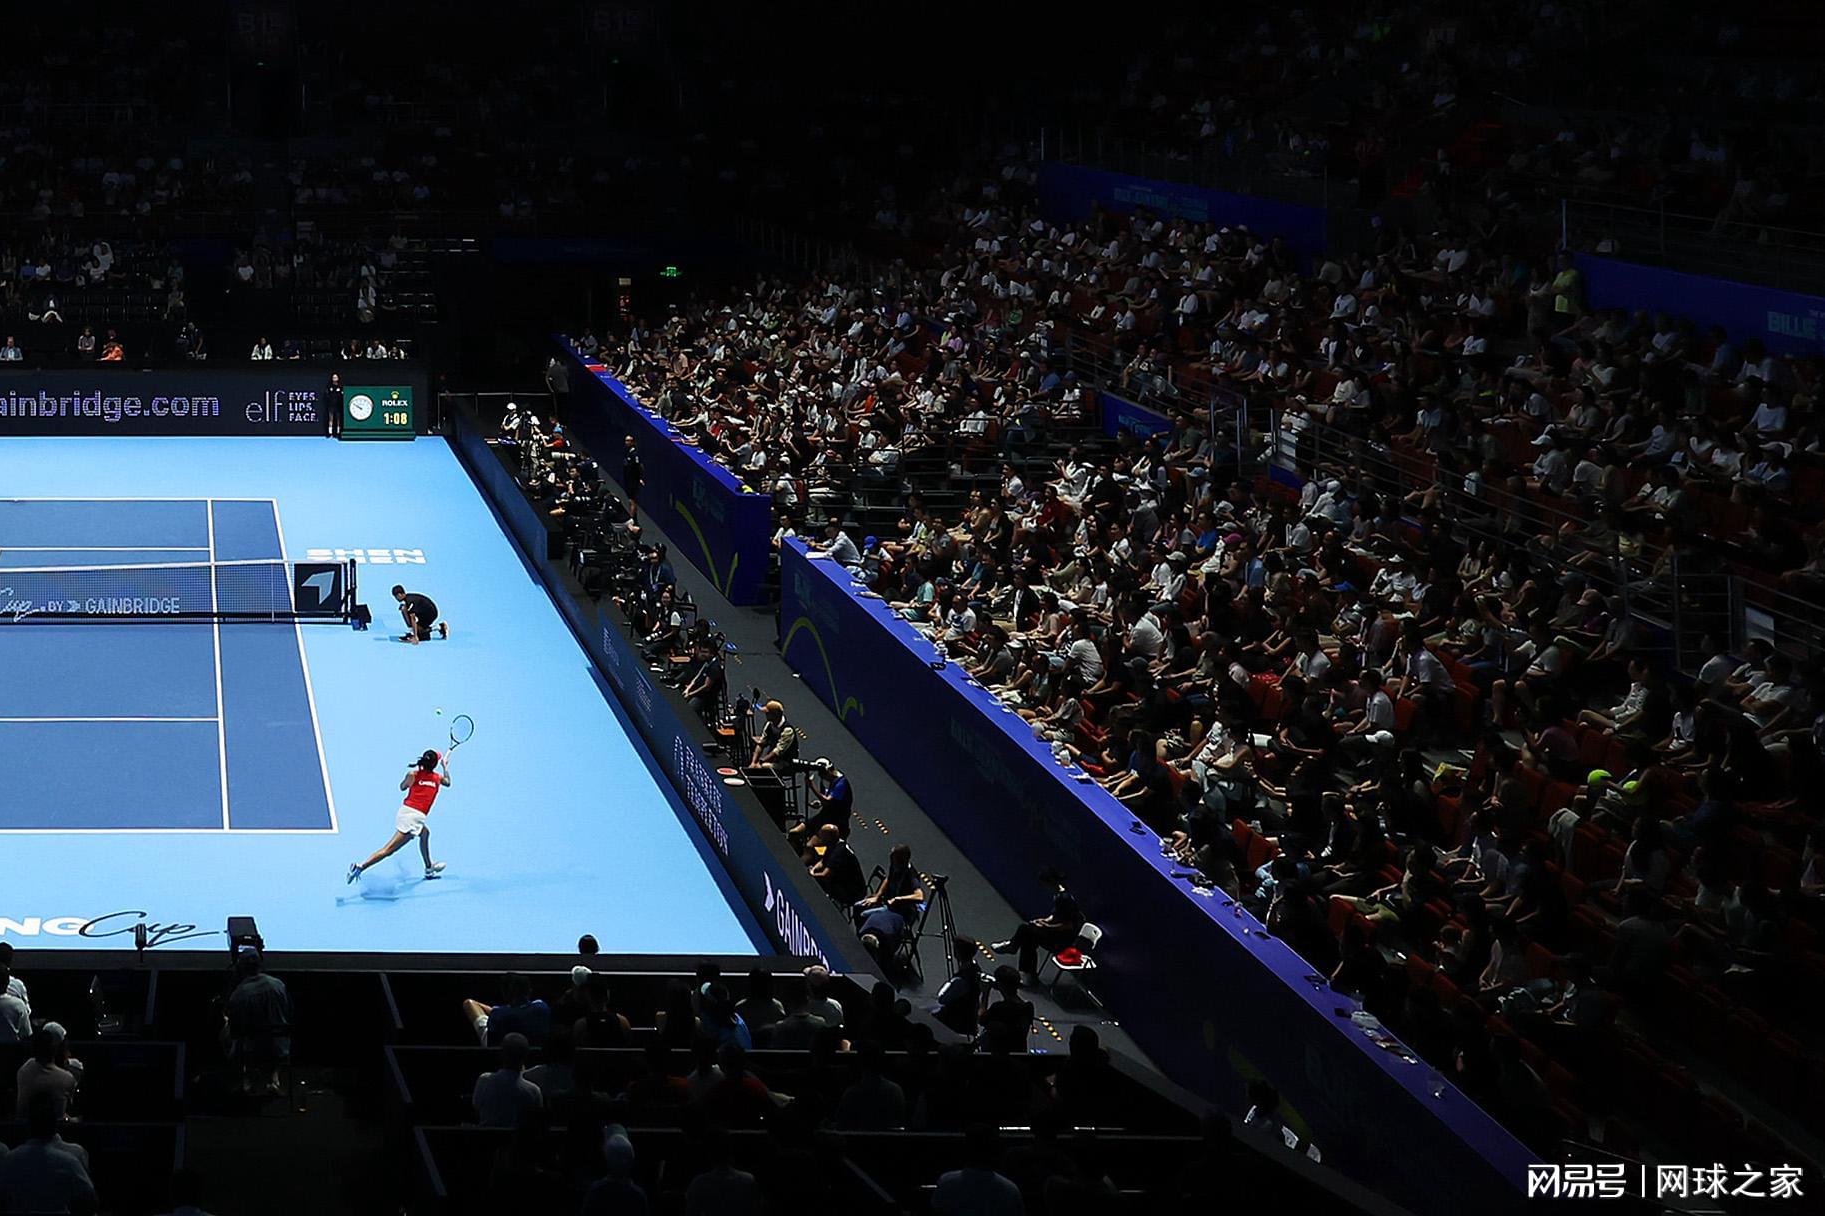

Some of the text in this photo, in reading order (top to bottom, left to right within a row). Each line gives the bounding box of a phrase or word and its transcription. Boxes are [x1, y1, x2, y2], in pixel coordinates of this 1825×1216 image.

[383, 412, 408, 425] 1:08
[47, 601, 64, 612] BY
[85, 598, 181, 613] GAINBRIDGE
